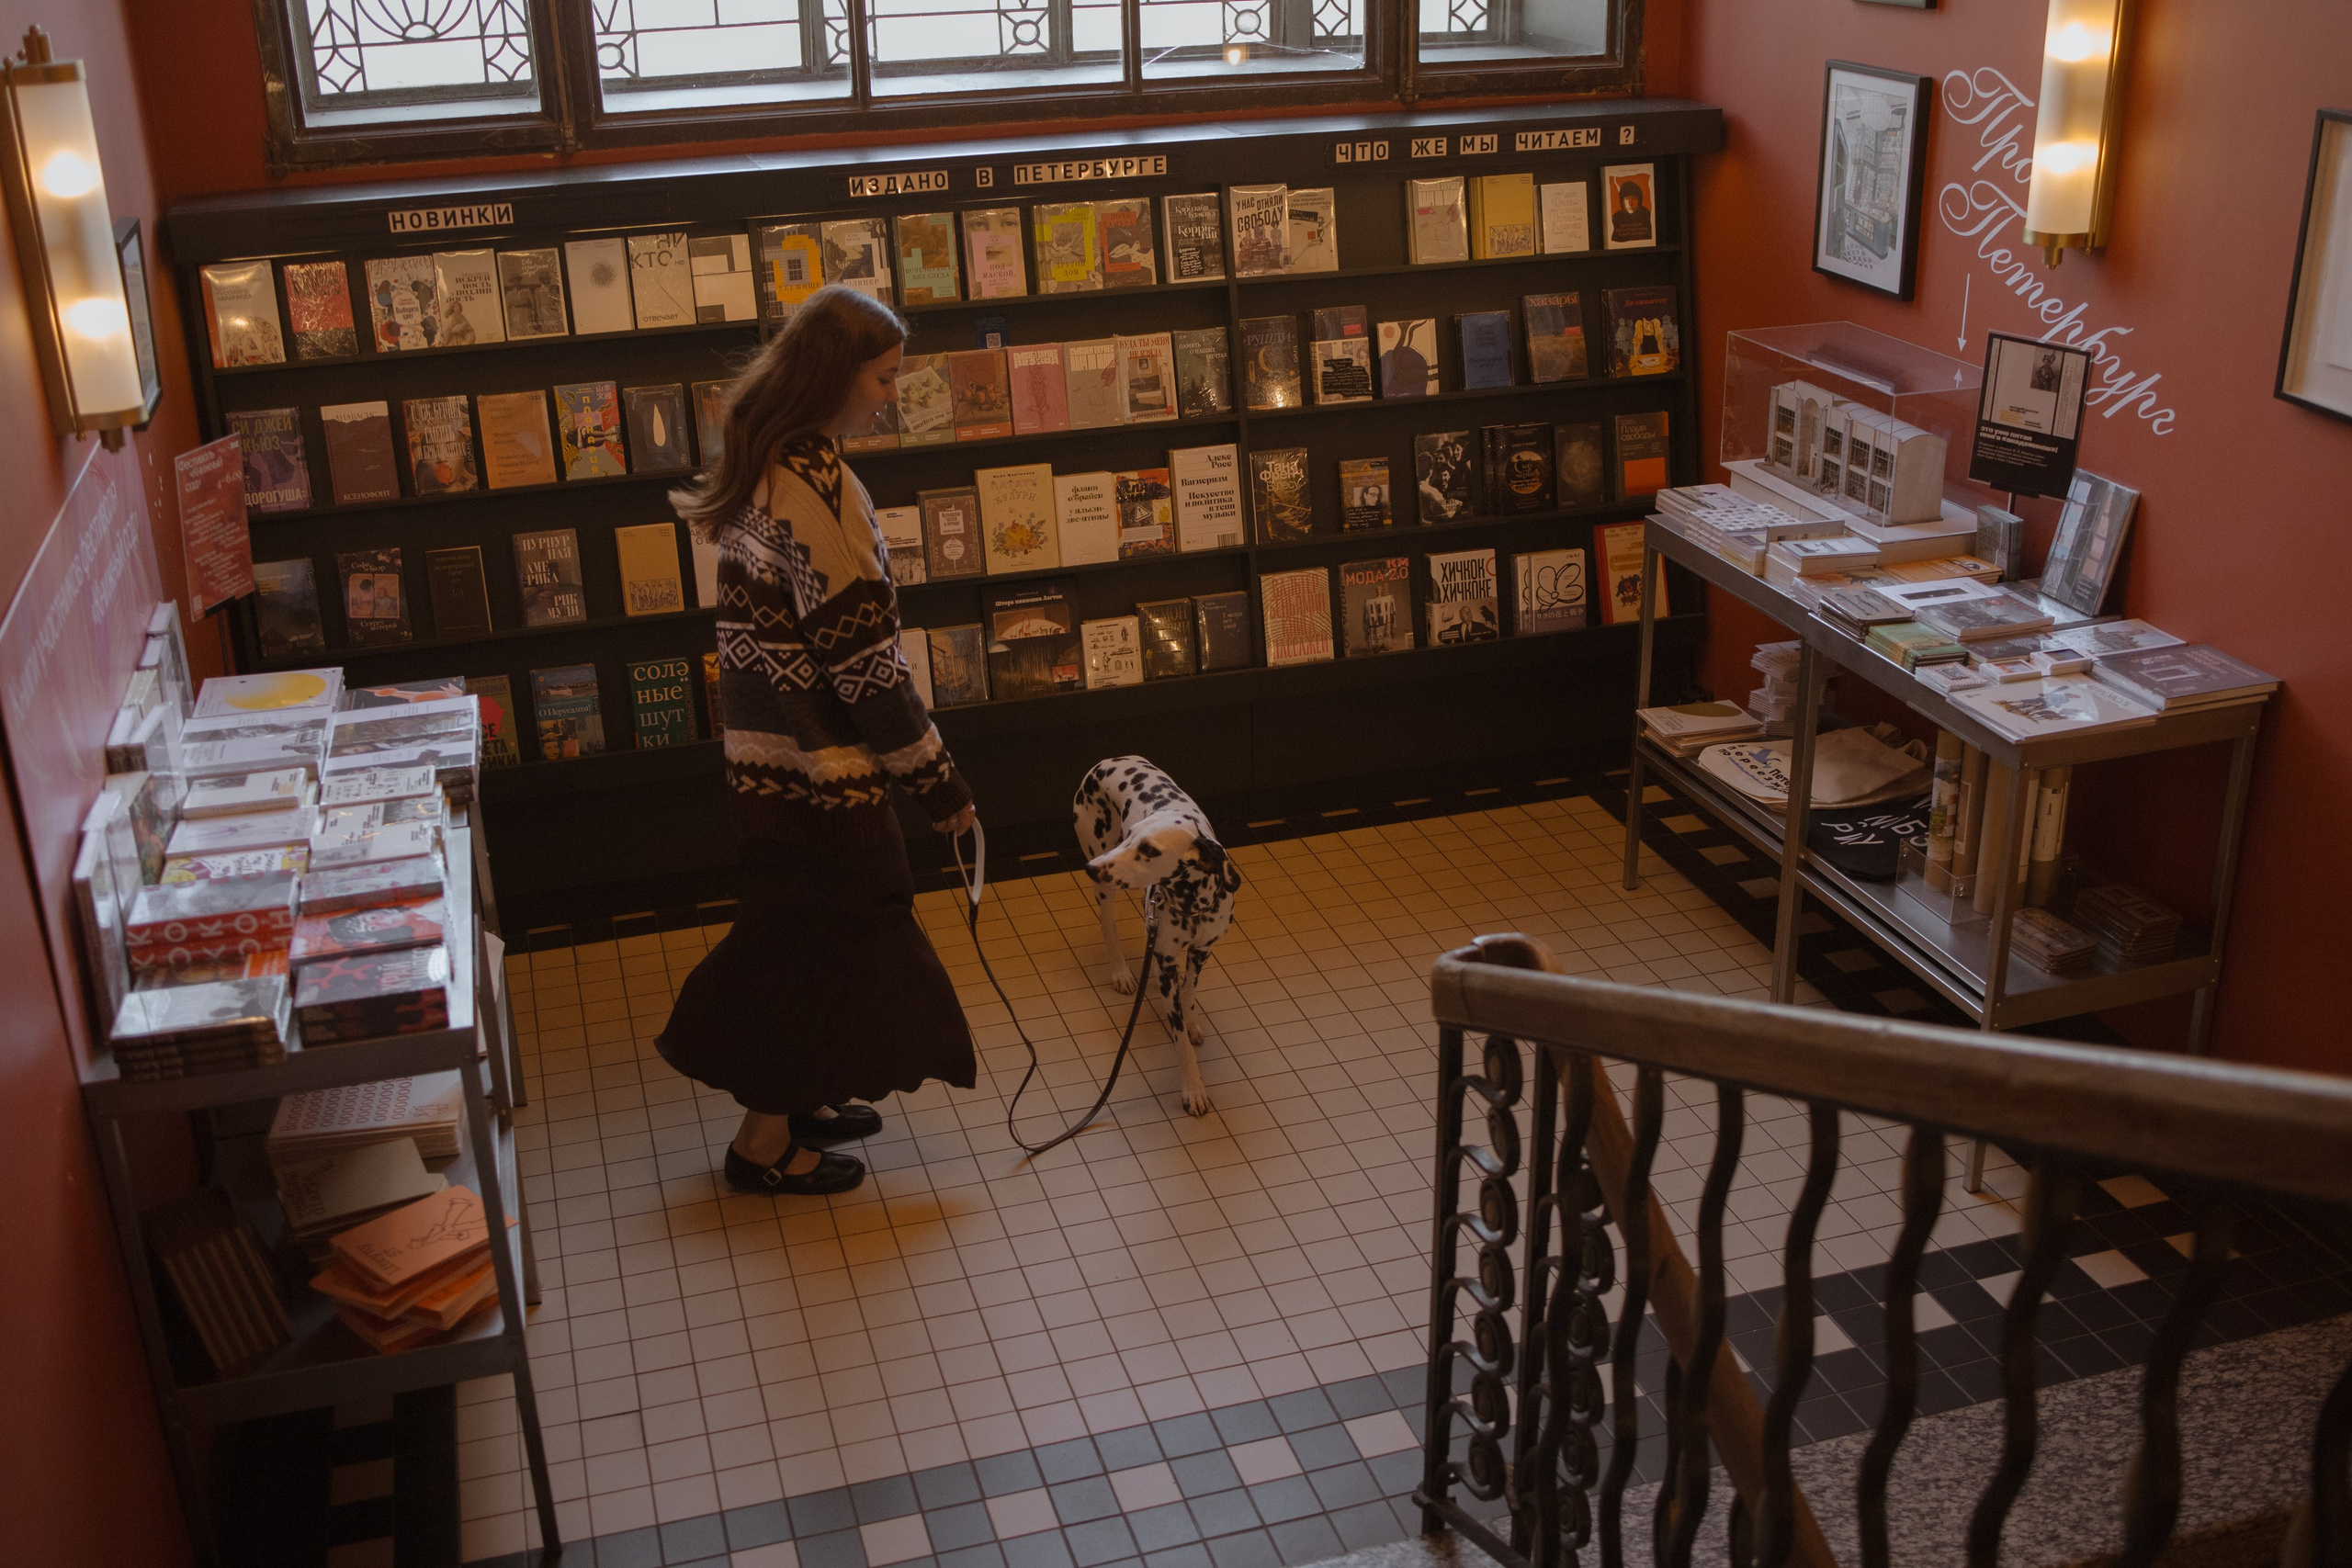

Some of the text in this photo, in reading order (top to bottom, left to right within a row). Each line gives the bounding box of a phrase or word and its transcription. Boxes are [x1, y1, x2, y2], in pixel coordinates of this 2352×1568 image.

[1942, 67, 2034, 182] Про
[1339, 129, 1632, 160] ЧТО ЖЕ МЫ ЧИТАЕМ ?
[851, 157, 1164, 195] ИЗДАНО В ПЕТЕРБУРГЕ
[1236, 194, 1283, 211] У НАС ОТНЯЛИ
[390, 206, 512, 231] НОВИНКИ
[1237, 206, 1283, 233] СВОБОДУ
[656, 232, 685, 249] НИ
[629, 250, 673, 269] КТО
[1063, 268, 1080, 276] ДОМ
[455, 276, 491, 284] ИСКРЕН
[778, 281, 821, 292] УБЕЖИЩЕ
[1529, 294, 1577, 308] хазары
[1939, 180, 2177, 435] Петербург
[394, 306, 418, 315] Выберите
[643, 312, 679, 322] отвечает
[1139, 338, 1149, 347] ТЫ
[1150, 336, 1170, 346] МЕНЯ
[1247, 333, 1292, 346] РУШДИ
[1129, 351, 1139, 359] НЕ
[334, 411, 378, 421] АНАБАСИС
[232, 417, 292, 434] СИ ДЖЕЙ
[1621, 424, 1646, 434] Пламя
[1621, 431, 1656, 442] свободы
[1205, 454, 1231, 463] Алекс
[1211, 460, 1232, 469] Росс
[1265, 460, 1298, 472] Тана
[1181, 476, 1228, 488] Вагнеризм
[1274, 479, 1300, 490] лесу
[344, 490, 390, 502] КСЕНОФОНТ
[1188, 489, 1235, 501] Искусство
[1191, 497, 1233, 508] политика
[1215, 503, 1236, 512] тени
[1202, 511, 1237, 521] музыки
[522, 535, 571, 551] ПУРПУР
[548, 547, 572, 560] НАЯ
[526, 560, 549, 575] АМЕ
[1440, 558, 1485, 583] ХИЧКОК
[526, 571, 560, 586] РИКА
[1346, 566, 1408, 586] МОДА 2.0
[1442, 579, 1492, 604] ХИЧКОКЕ
[553, 593, 578, 607] РИК
[1536, 608, 1584, 620] リラの花と戦争
[1274, 632, 1329, 660] ПАССАЖЕЙ
[637, 684, 683, 705] ные
[538, 704, 592, 718] О Иерусалим!
[639, 707, 684, 730] шут
[481, 723, 496, 739] СЕ
[481, 739, 508, 756] ЕТА
[642, 732, 670, 749] ки
